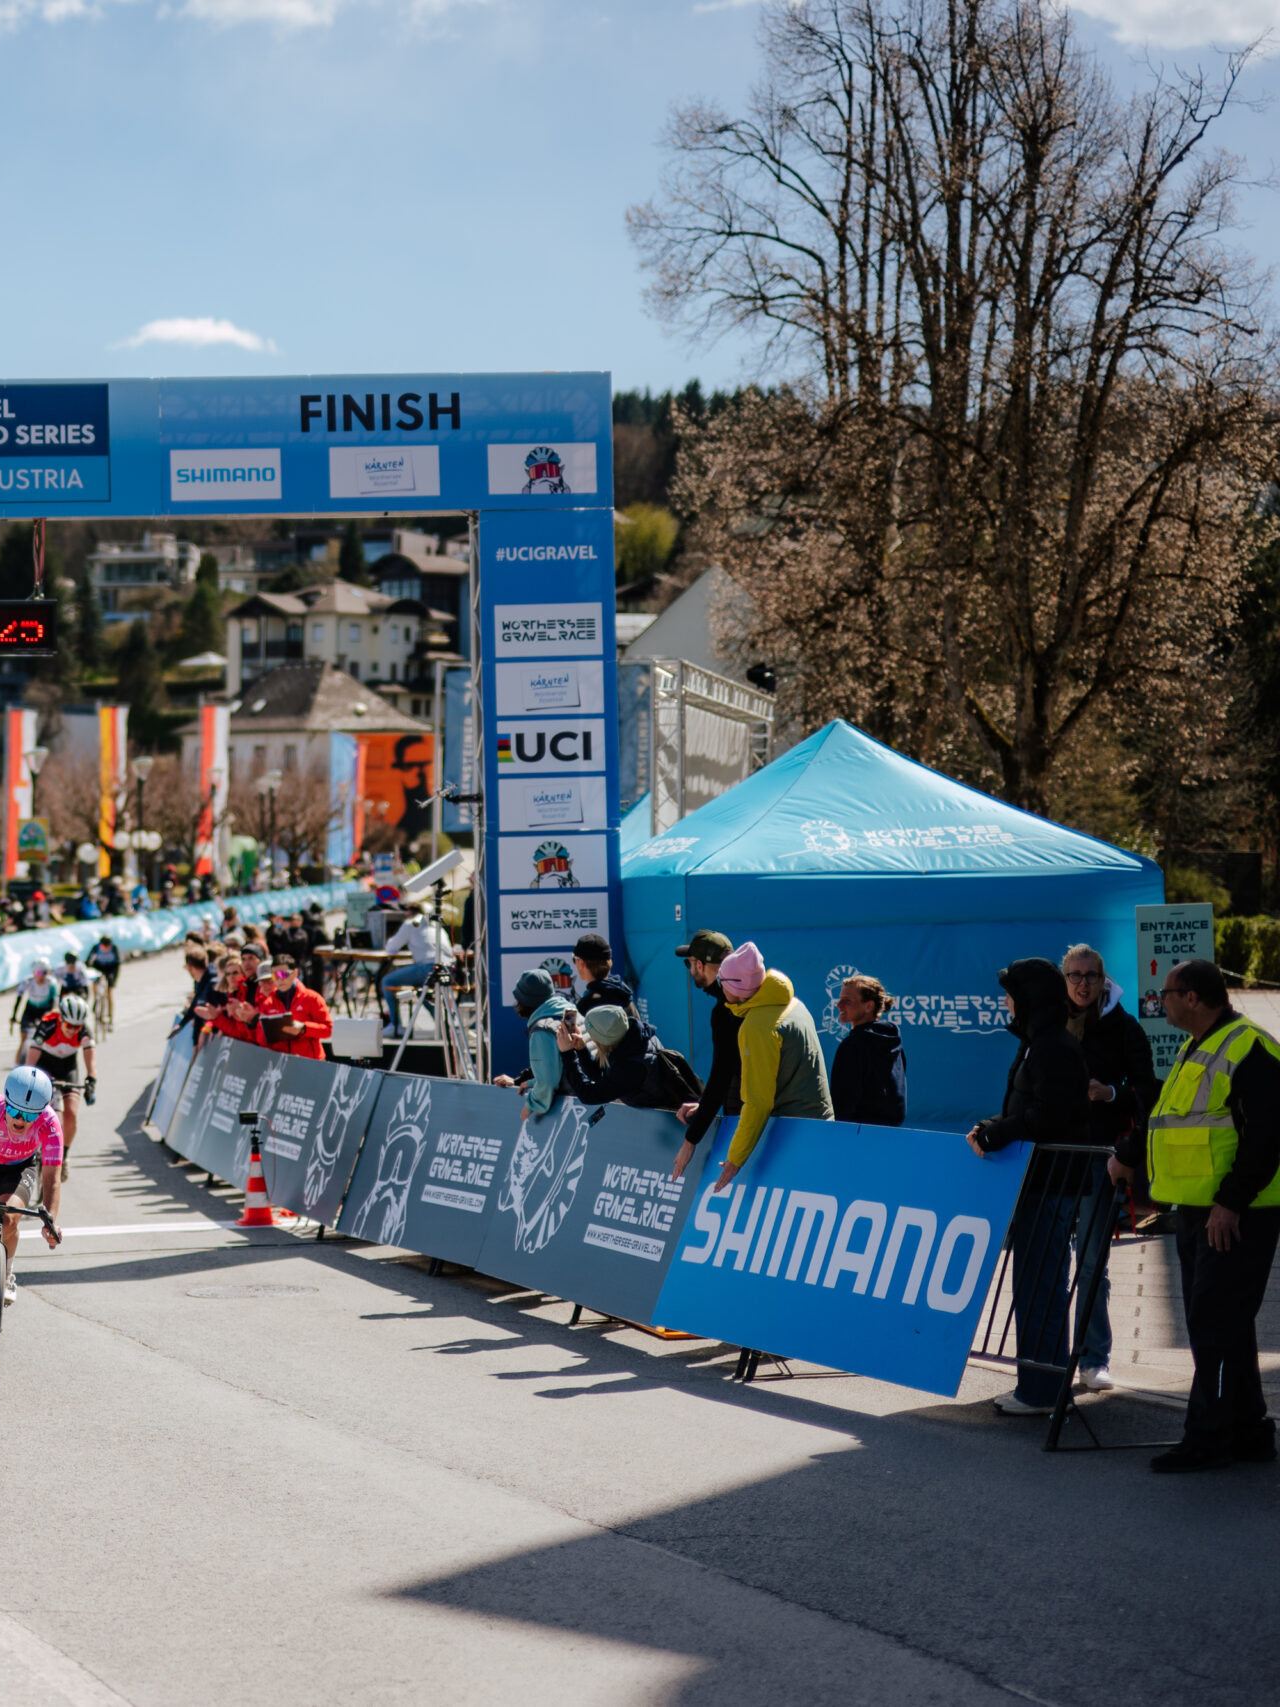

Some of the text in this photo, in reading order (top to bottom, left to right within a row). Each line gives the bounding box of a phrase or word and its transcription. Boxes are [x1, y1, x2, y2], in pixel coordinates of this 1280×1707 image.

[299, 392, 461, 433] FINISH
[15, 423, 96, 445] SERIES
[176, 466, 276, 484] SHIMANO
[495, 545, 598, 561] #UCIGRAVEL
[502, 630, 596, 643] GRAVEL RACE
[515, 731, 592, 762] UCI
[511, 919, 598, 930] GRAVEL RACE
[1140, 920, 1209, 931] ENTRANCE
[1154, 932, 1196, 943] START
[1154, 944, 1196, 954] BLOCK
[888, 1011, 1013, 1025] GRAVEL RAC
[638, 1201, 677, 1232] RACE
[681, 1181, 991, 1314] SHIMANO
